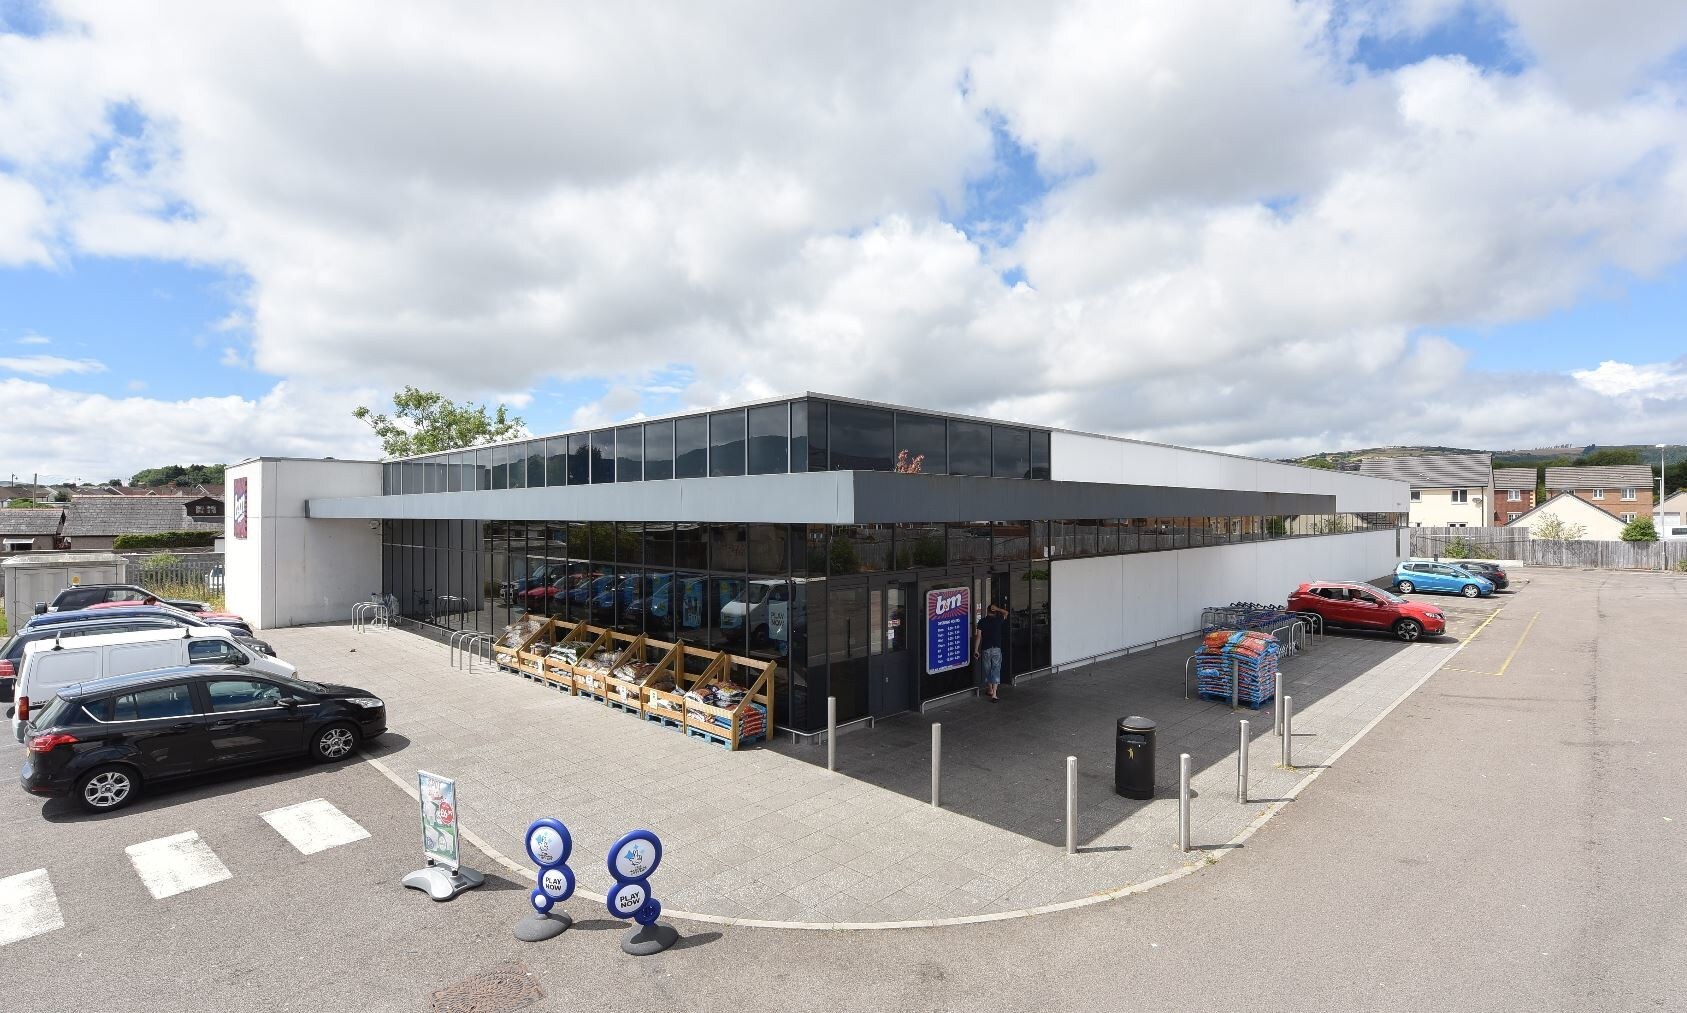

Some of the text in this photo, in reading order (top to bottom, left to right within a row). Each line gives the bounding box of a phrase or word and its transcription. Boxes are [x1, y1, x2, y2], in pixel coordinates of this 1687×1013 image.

[545, 877, 562, 885] PLAY
[620, 891, 640, 902] PLAY
[620, 898, 640, 908] NOW
